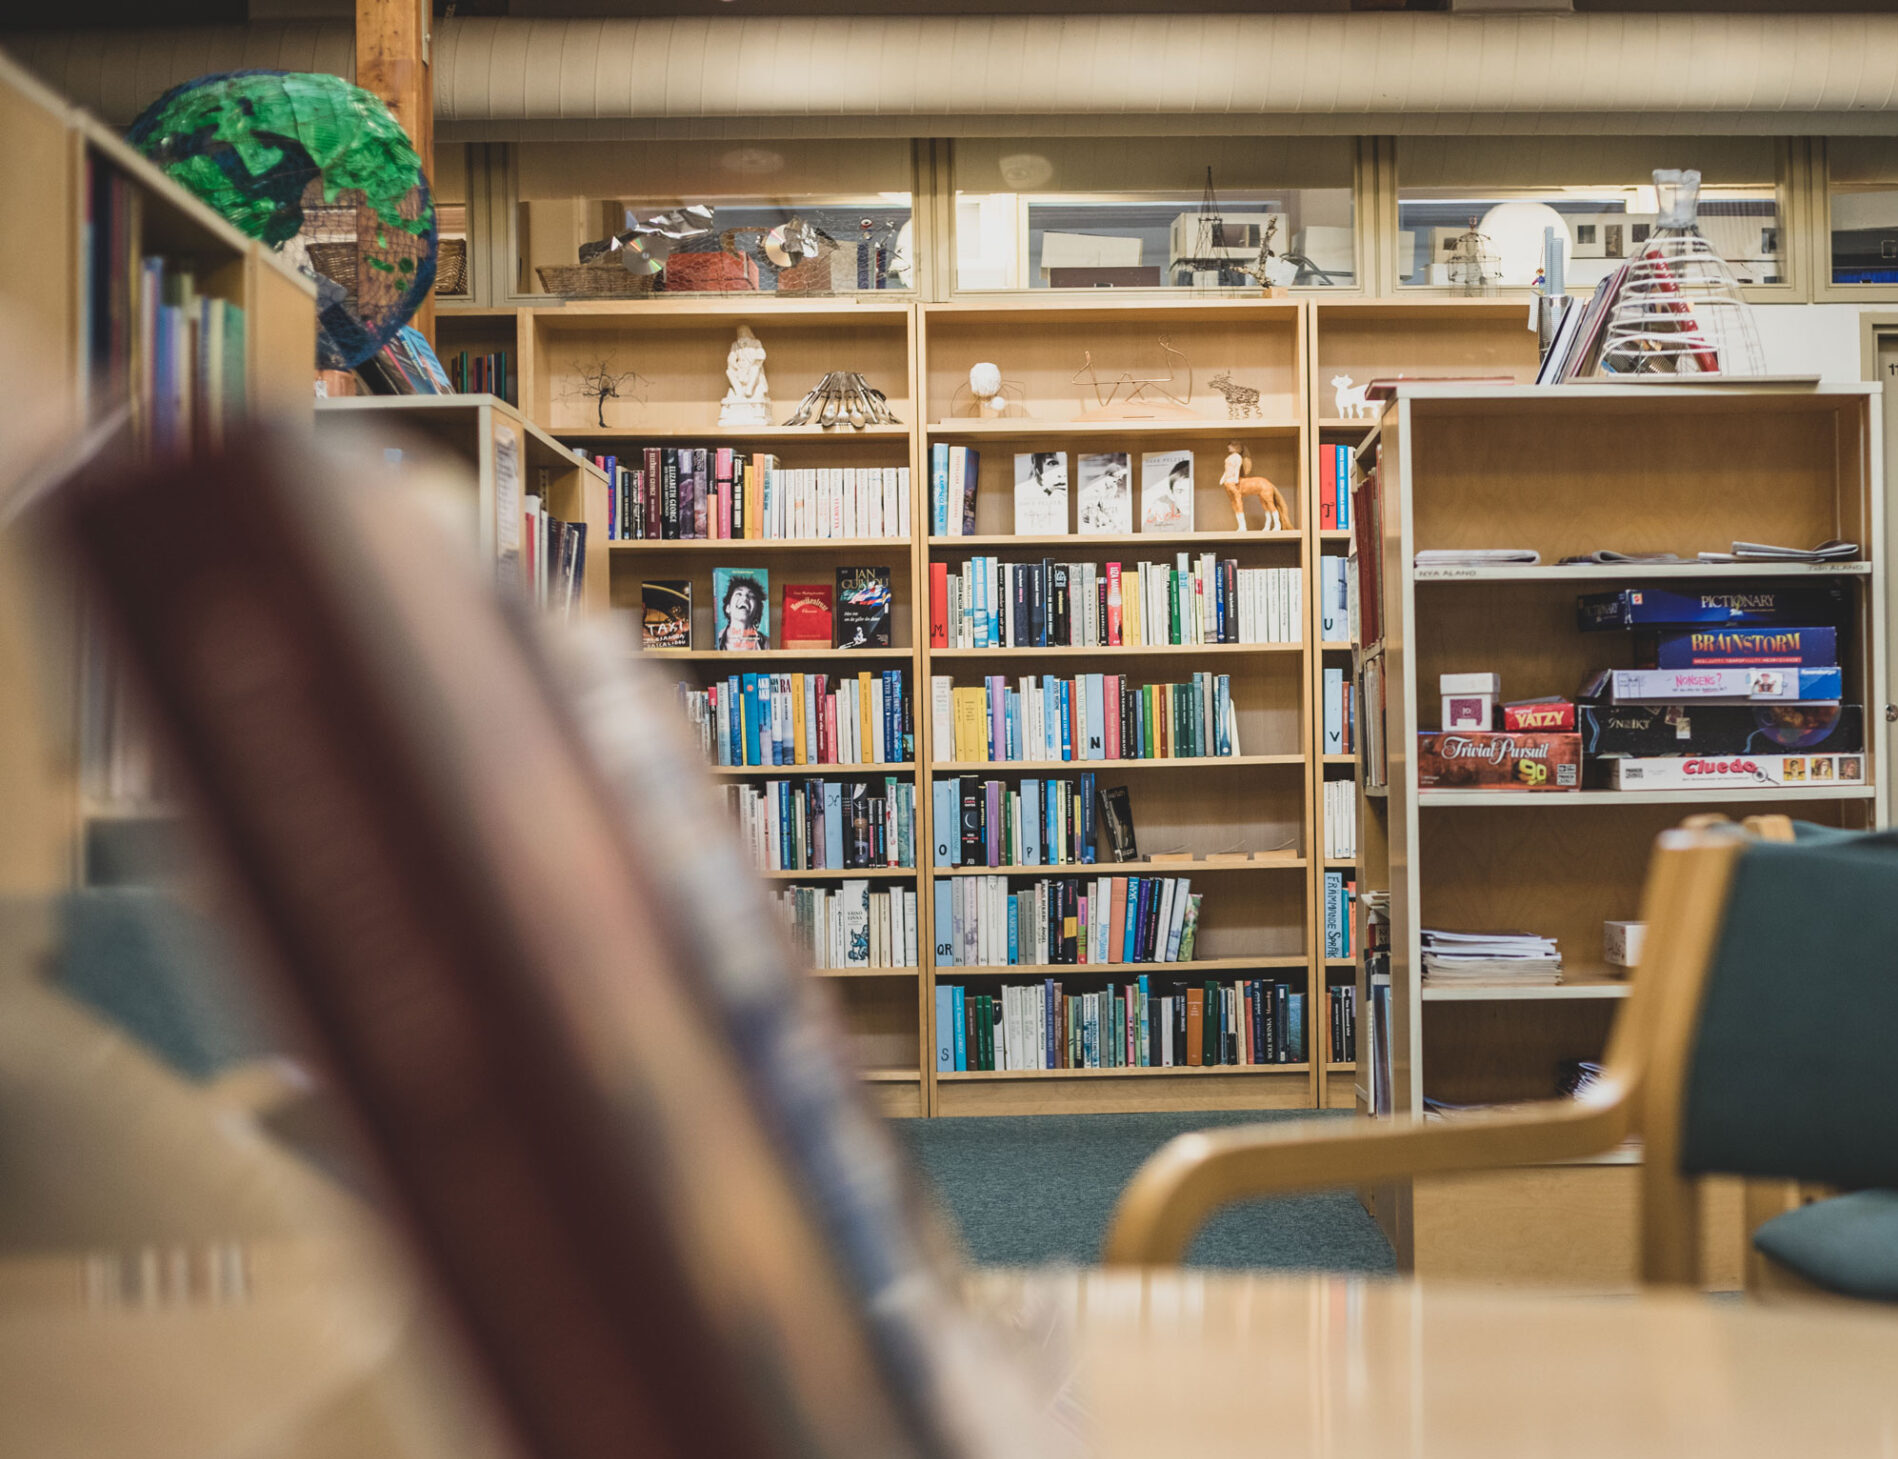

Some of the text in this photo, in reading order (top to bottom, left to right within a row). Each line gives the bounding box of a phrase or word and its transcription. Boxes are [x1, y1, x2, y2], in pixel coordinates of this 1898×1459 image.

[669, 466, 678, 523] ELIZABETH GEORGE
[855, 568, 876, 580] JAN
[1701, 594, 1776, 609] PICTIONARY
[647, 621, 684, 636] TAXI
[931, 623, 945, 638] M
[1324, 618, 1333, 631] U
[1691, 632, 1802, 655] BRAINSTORM
[1675, 672, 1723, 688] NONSENS?
[1514, 711, 1566, 729] YATZY
[1090, 736, 1101, 750] N
[1329, 731, 1341, 742] V
[1441, 736, 1550, 765] Trivial Pursuit
[1518, 758, 1548, 782] 90
[1682, 758, 1758, 775] Cluedo
[937, 943, 953, 956] QR
[941, 1048, 950, 1062] S
